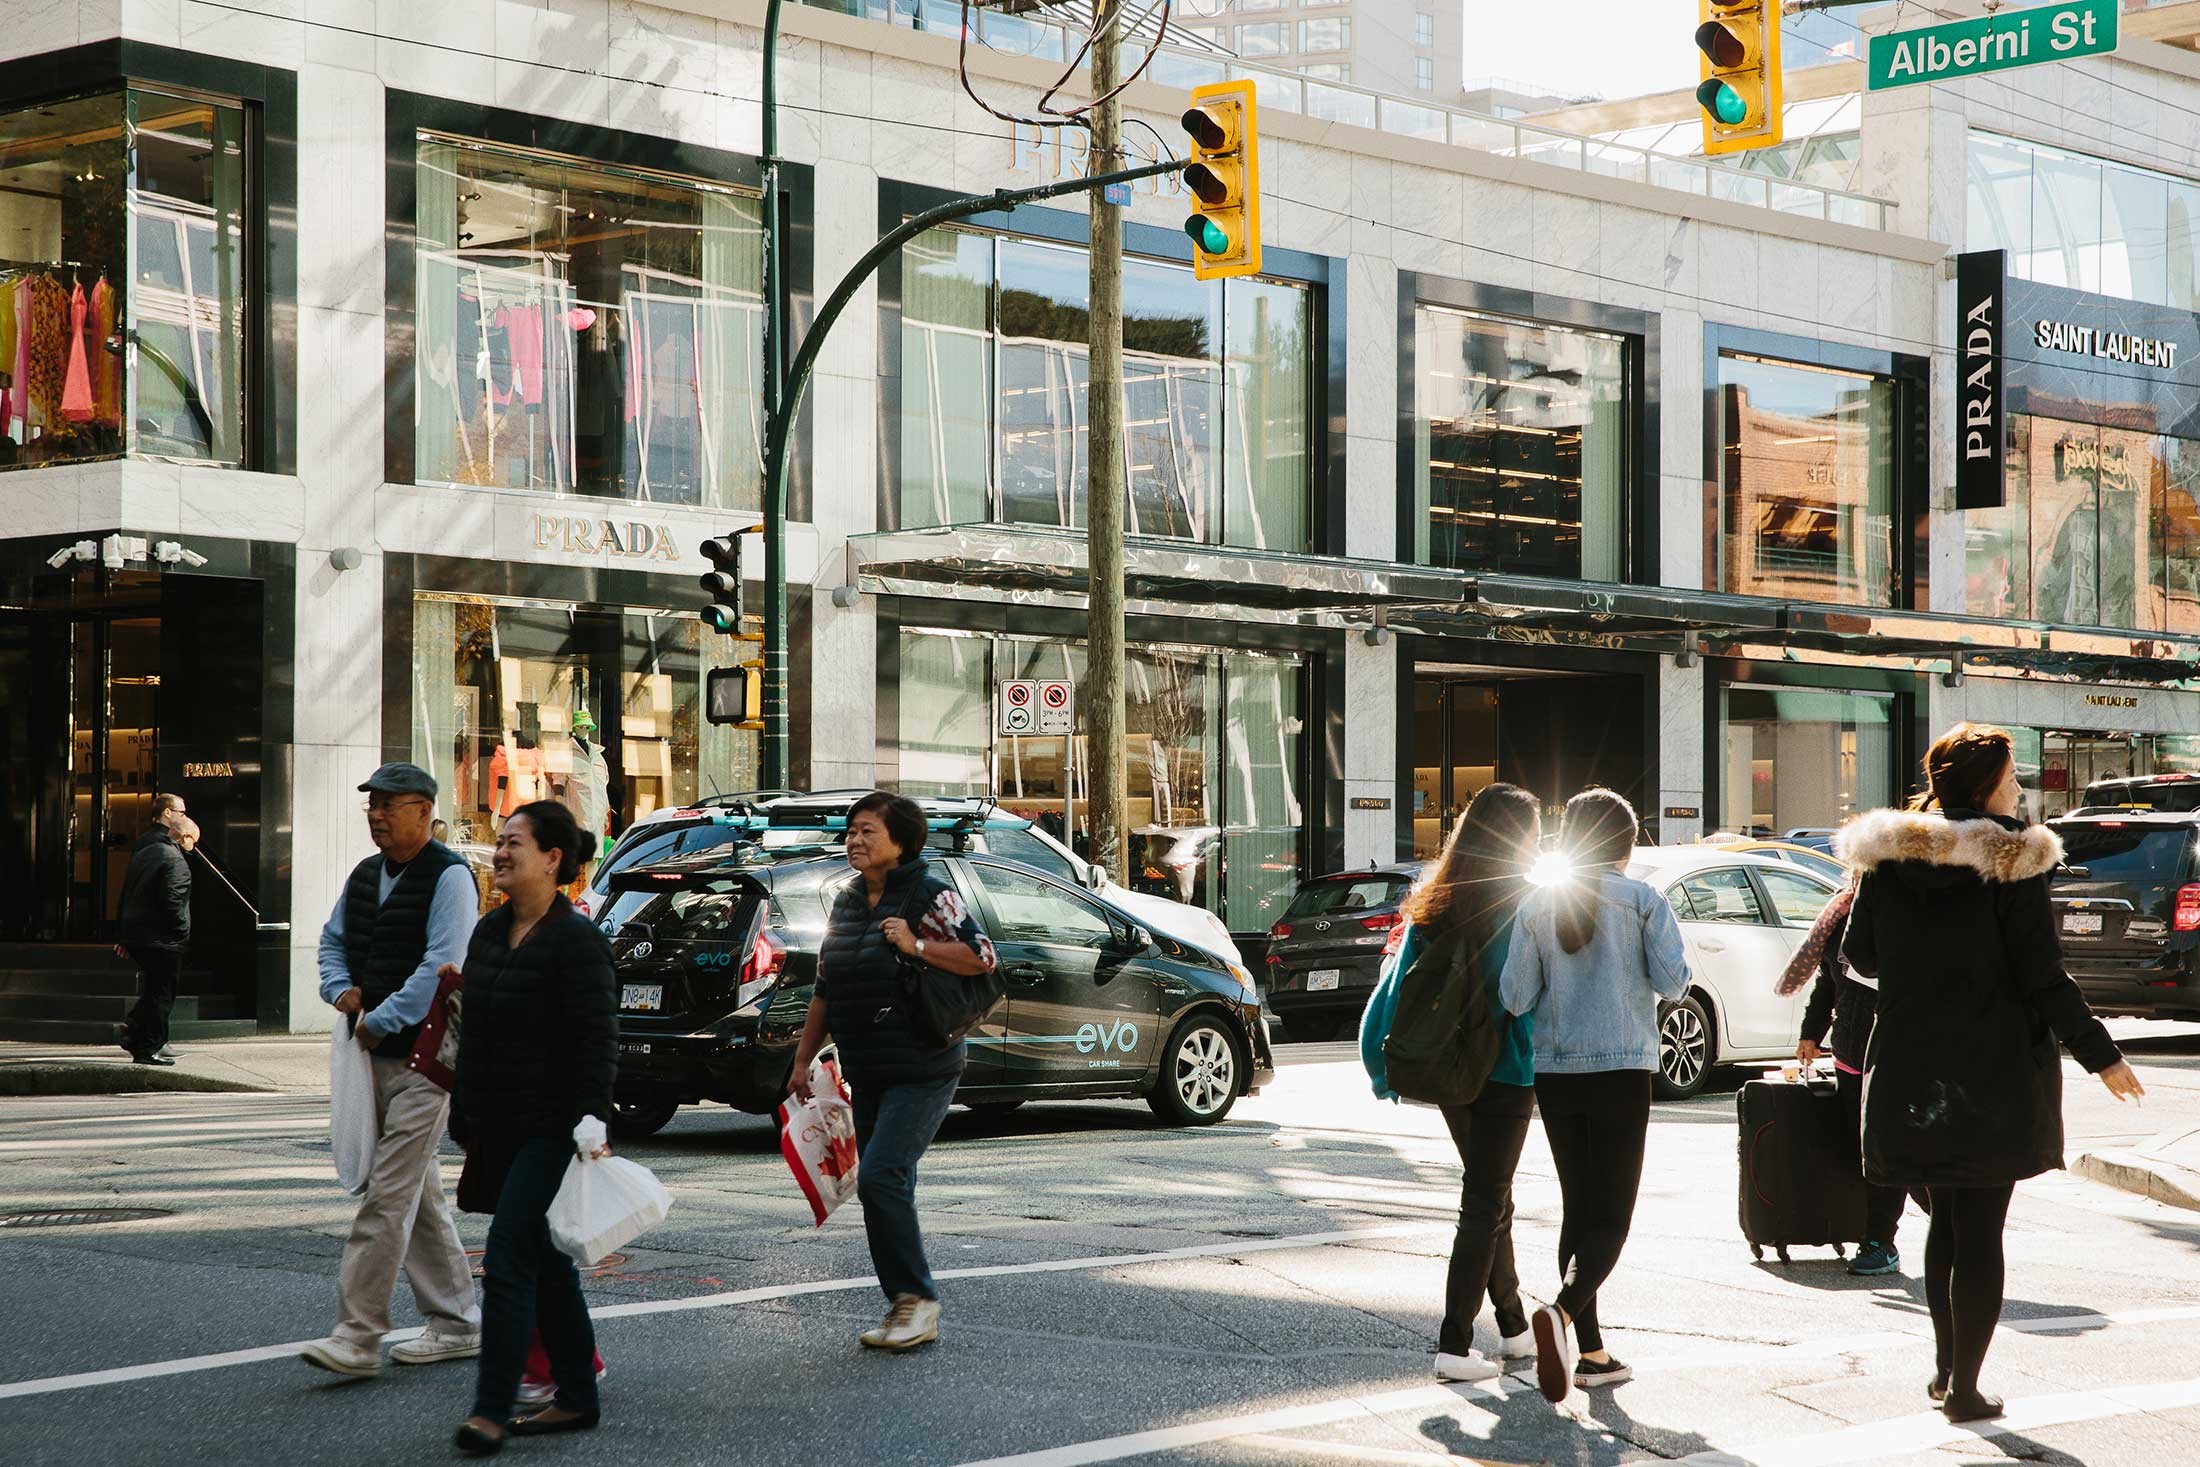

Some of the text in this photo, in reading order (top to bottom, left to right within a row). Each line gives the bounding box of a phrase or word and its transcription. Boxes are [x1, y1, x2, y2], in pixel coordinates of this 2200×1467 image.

[1888, 10, 2097, 79] Alberni St
[2036, 320, 2177, 368] SAINT LAURENT
[1967, 295, 1992, 461] PRADA
[534, 512, 680, 561] PRADA
[183, 762, 233, 777] PRADA
[694, 952, 731, 966] evo
[1075, 1017, 1138, 1053] evo
